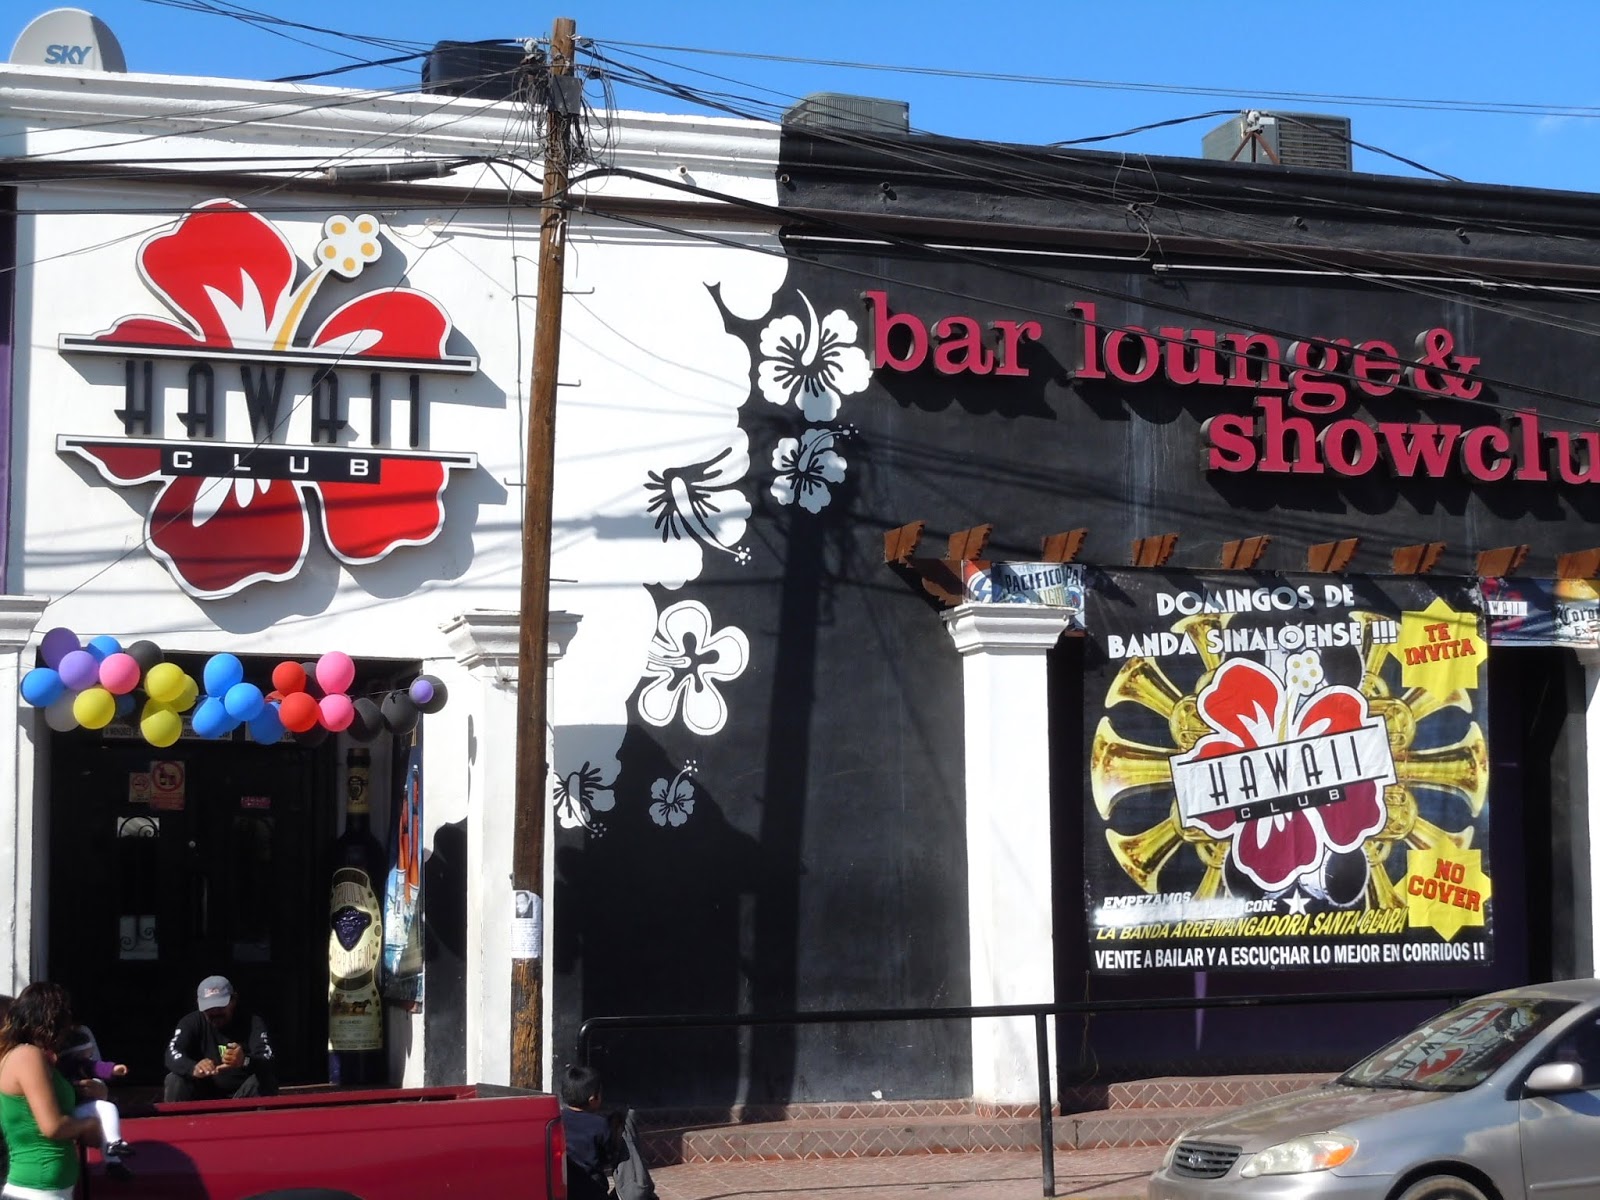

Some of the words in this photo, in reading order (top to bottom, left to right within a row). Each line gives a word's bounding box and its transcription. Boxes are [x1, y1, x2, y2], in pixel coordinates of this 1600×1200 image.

[45, 44, 91, 65] SKY
[862, 291, 1042, 378] bar
[1070, 301, 1401, 415] lounge
[1409, 327, 1481, 400] &
[114, 360, 420, 449] HAWAII
[172, 450, 370, 477] CLUB
[1005, 568, 1061, 593] PACIFICO
[1156, 585, 1315, 616] DOMINGOS
[1324, 584, 1355, 608] DE
[1484, 601, 1520, 615] AWAII
[1558, 604, 1600, 626] Coro
[1107, 632, 1198, 659] BANDA
[1206, 622, 1363, 655] SINALOENSE
[1424, 622, 1451, 642] TE
[1404, 638, 1476, 666] INVITA
[1208, 735, 1362, 806] HAWAII
[1241, 789, 1340, 819] CLUB
[1434, 858, 1465, 884] NO
[1102, 892, 1192, 910] EMPEZAMOS
[1244, 899, 1278, 913] CON:
[1408, 874, 1481, 912] COVER
[1096, 927, 1116, 940] LA
[1119, 923, 1171, 940] BANDA
[1169, 914, 1311, 939] ARREMANGADORA
[1309, 910, 1361, 935] SANTA
[1359, 906, 1409, 935] CLARA
[1095, 950, 1142, 969] VENTE
[1143, 950, 1153, 968] A
[1155, 948, 1204, 967] BAILAR
[1205, 948, 1217, 966] Y
[1217, 948, 1228, 966] A
[1231, 945, 1311, 966] ESCUCHAR
[1313, 945, 1331, 964] LO
[1334, 944, 1381, 964] MEJOR
[1383, 943, 1400, 963] EN
[1402, 942, 1470, 962] CORRIDOS
